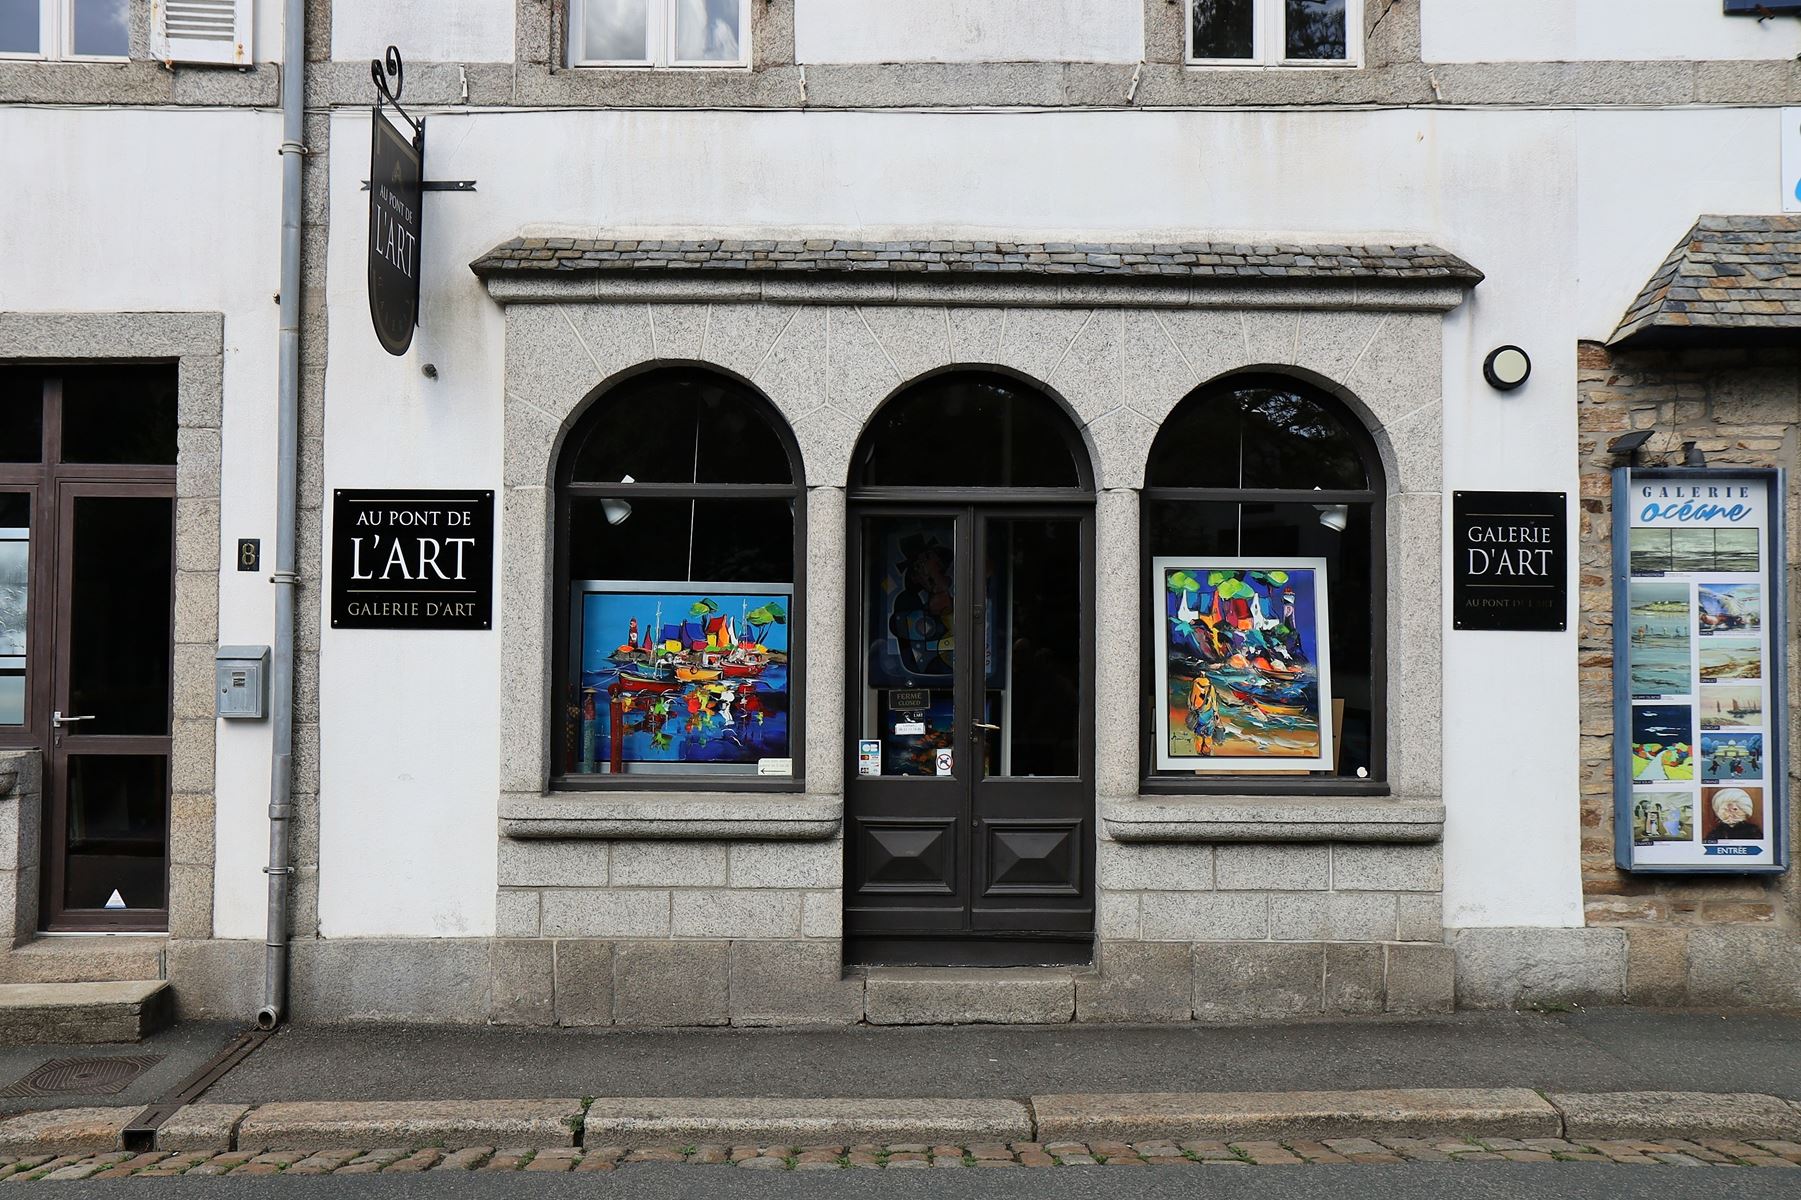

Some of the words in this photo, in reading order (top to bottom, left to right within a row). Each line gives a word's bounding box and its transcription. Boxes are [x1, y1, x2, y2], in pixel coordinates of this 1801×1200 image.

[379, 184, 388, 201] AU
[389, 191, 404, 218] PONT
[405, 210, 413, 225] DE
[375, 204, 416, 279] L'ART
[1642, 486, 1749, 498] GALERIE
[356, 511, 383, 526] AU
[389, 511, 441, 526] PONT
[447, 511, 471, 526] DE
[1640, 499, 1752, 522] océane
[1467, 526, 1551, 543] GALERIE
[241, 543, 256, 565] 8
[350, 534, 475, 580] L'ART
[1467, 548, 1553, 576] D'ART
[347, 602, 419, 617] GALERIE
[426, 602, 476, 617] D'ART
[1466, 599, 1480, 608] AU
[1482, 599, 1510, 608] PONT
[1717, 846, 1748, 855] ENTRÉE
